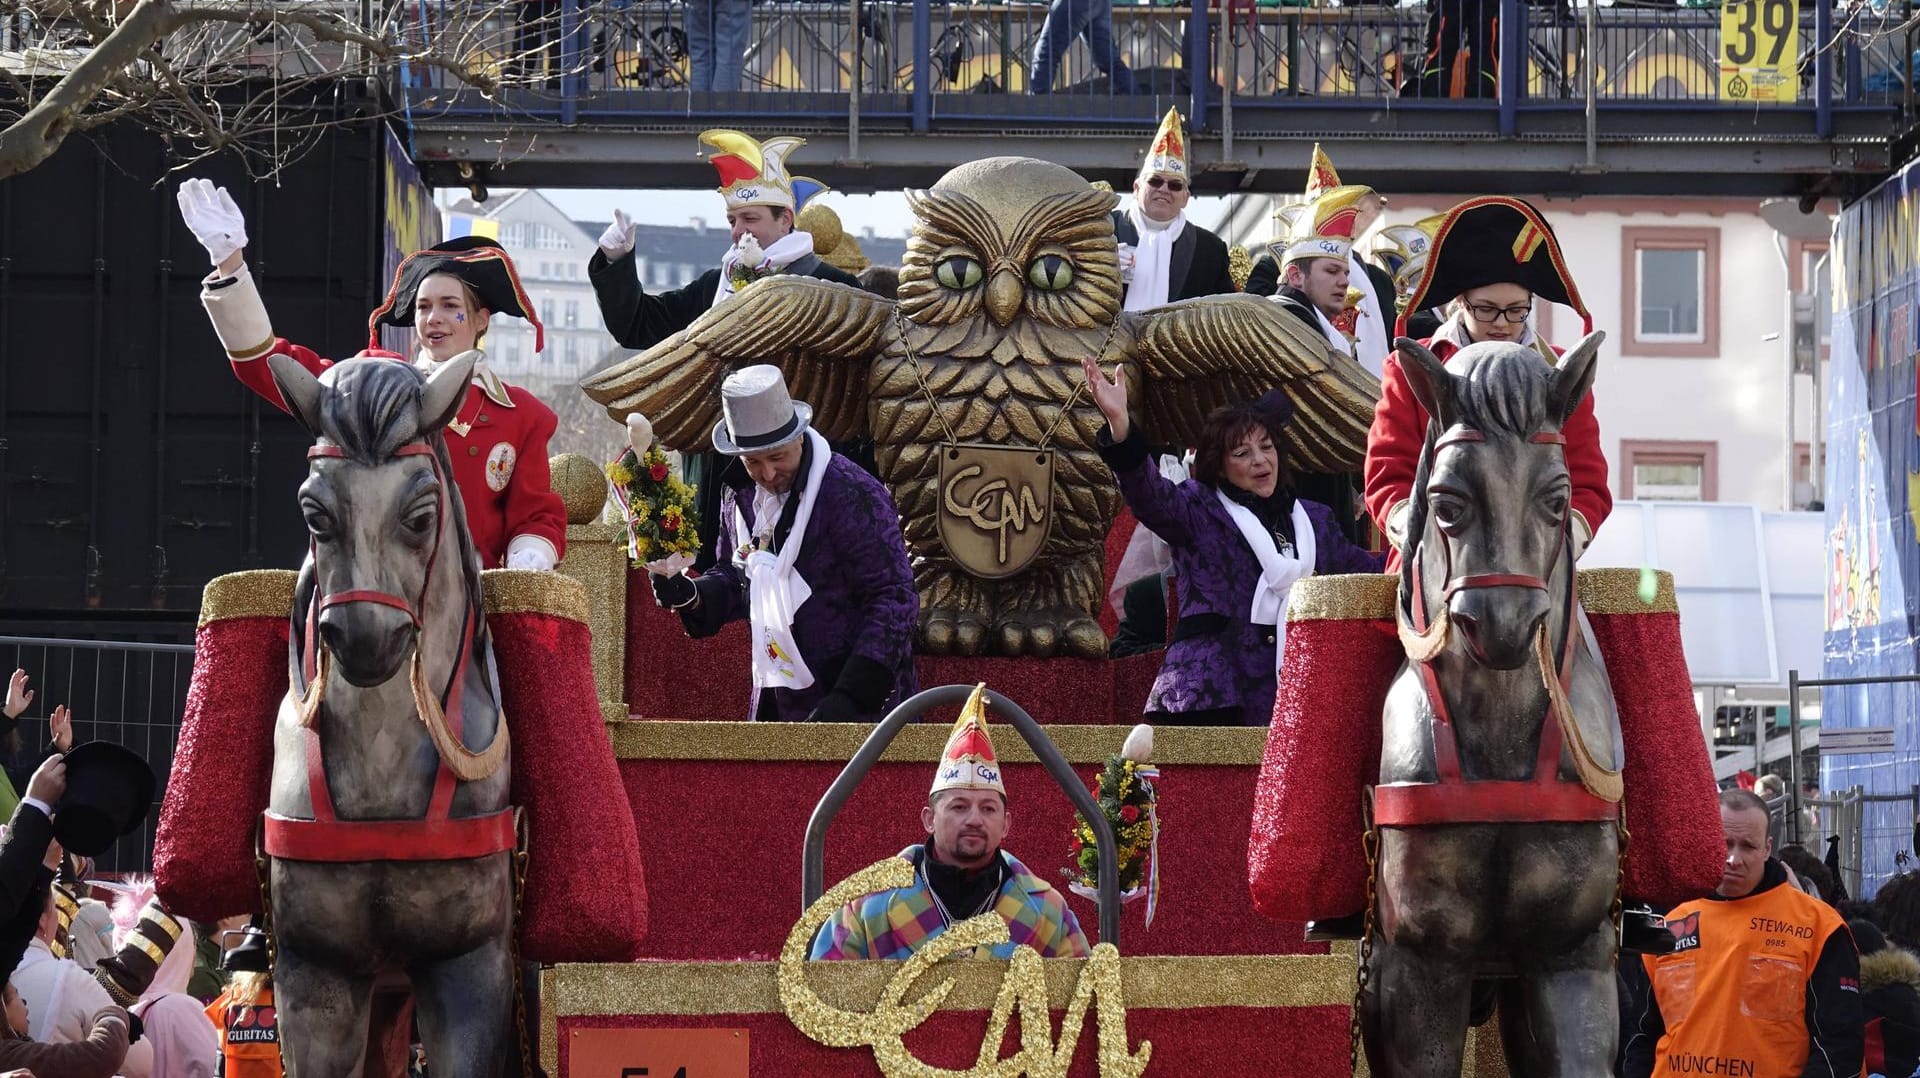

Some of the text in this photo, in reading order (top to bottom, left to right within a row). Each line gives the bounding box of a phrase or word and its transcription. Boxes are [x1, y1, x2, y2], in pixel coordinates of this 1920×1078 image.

[1726, 0, 1794, 65] 39
[1750, 917, 1814, 939] STEWARD
[1765, 938, 1786, 948] 0985
[1668, 1051, 1755, 1078] MÜNCHEN
